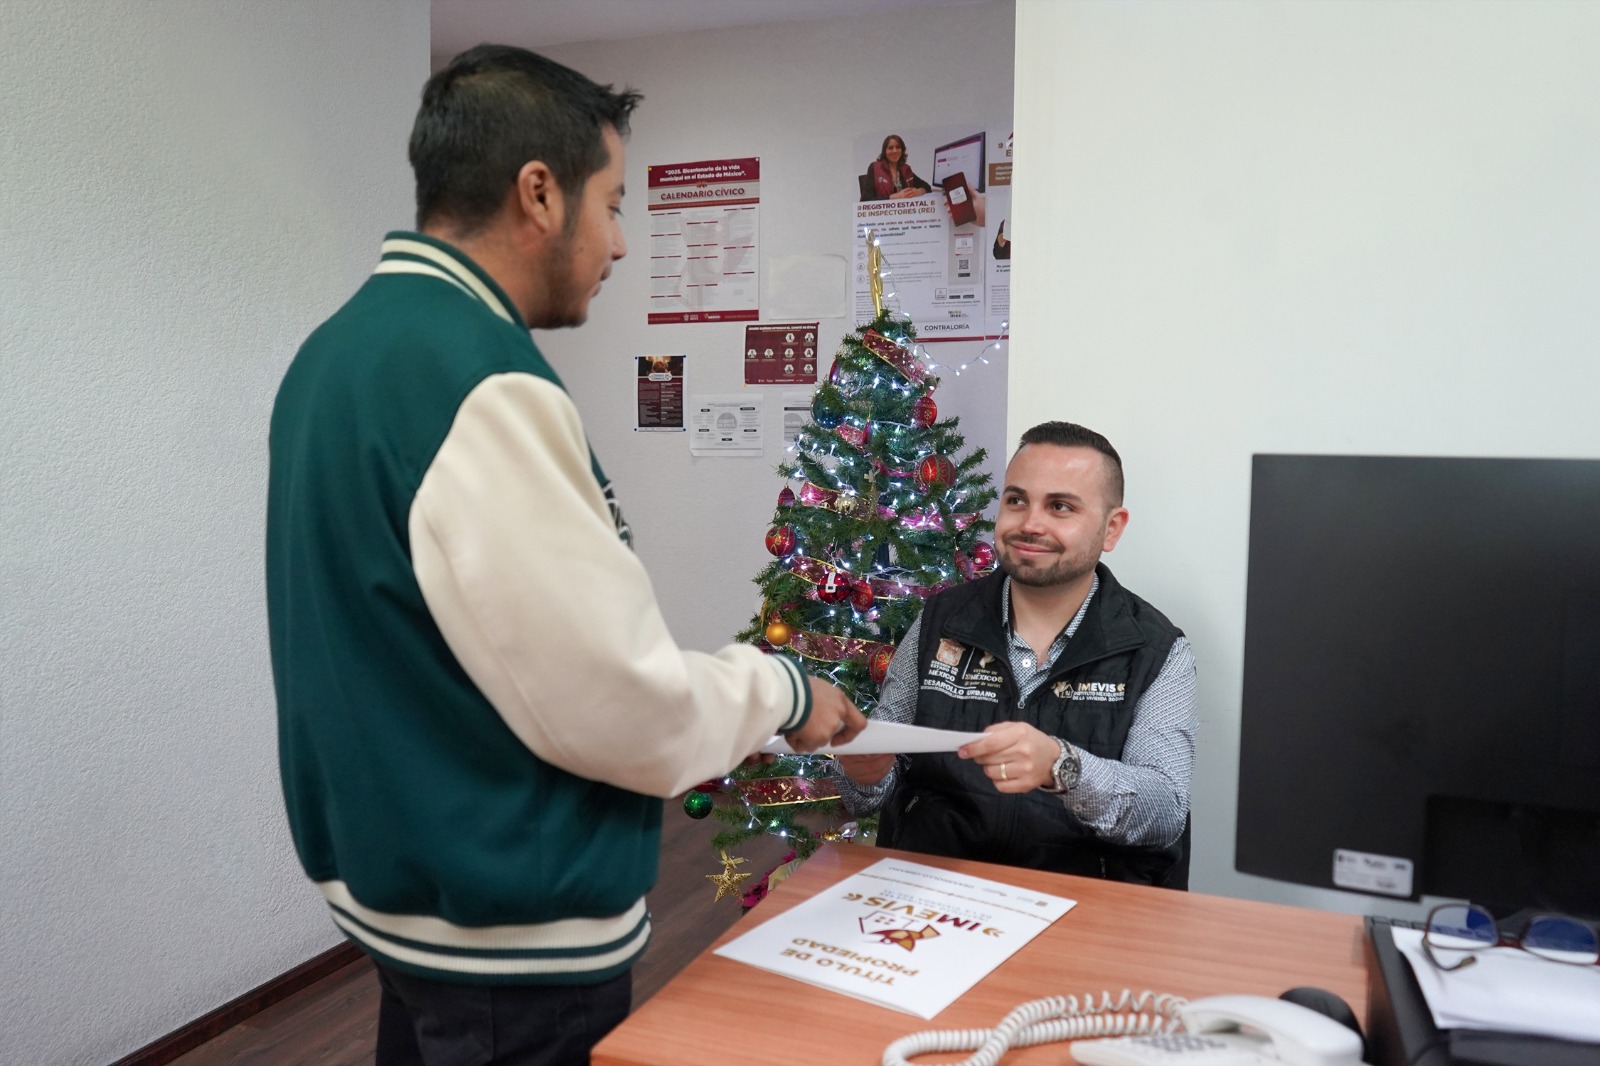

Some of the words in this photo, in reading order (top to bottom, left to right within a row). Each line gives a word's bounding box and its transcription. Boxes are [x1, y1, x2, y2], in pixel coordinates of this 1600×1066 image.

[661, 190, 713, 200] CALENDARIO
[715, 187, 745, 196] CÍVICO
[868, 208, 916, 217] INSPECTORES
[929, 668, 955, 681] MÉXICO
[971, 673, 997, 682] MÉXICO
[1078, 682, 1116, 692] IMEVIS
[967, 690, 996, 698] URBANO
[862, 896, 982, 931] IMEVIS
[780, 948, 812, 961] DE
[791, 937, 919, 977] PROPIEDAD
[816, 958, 895, 986] TÍTULO
